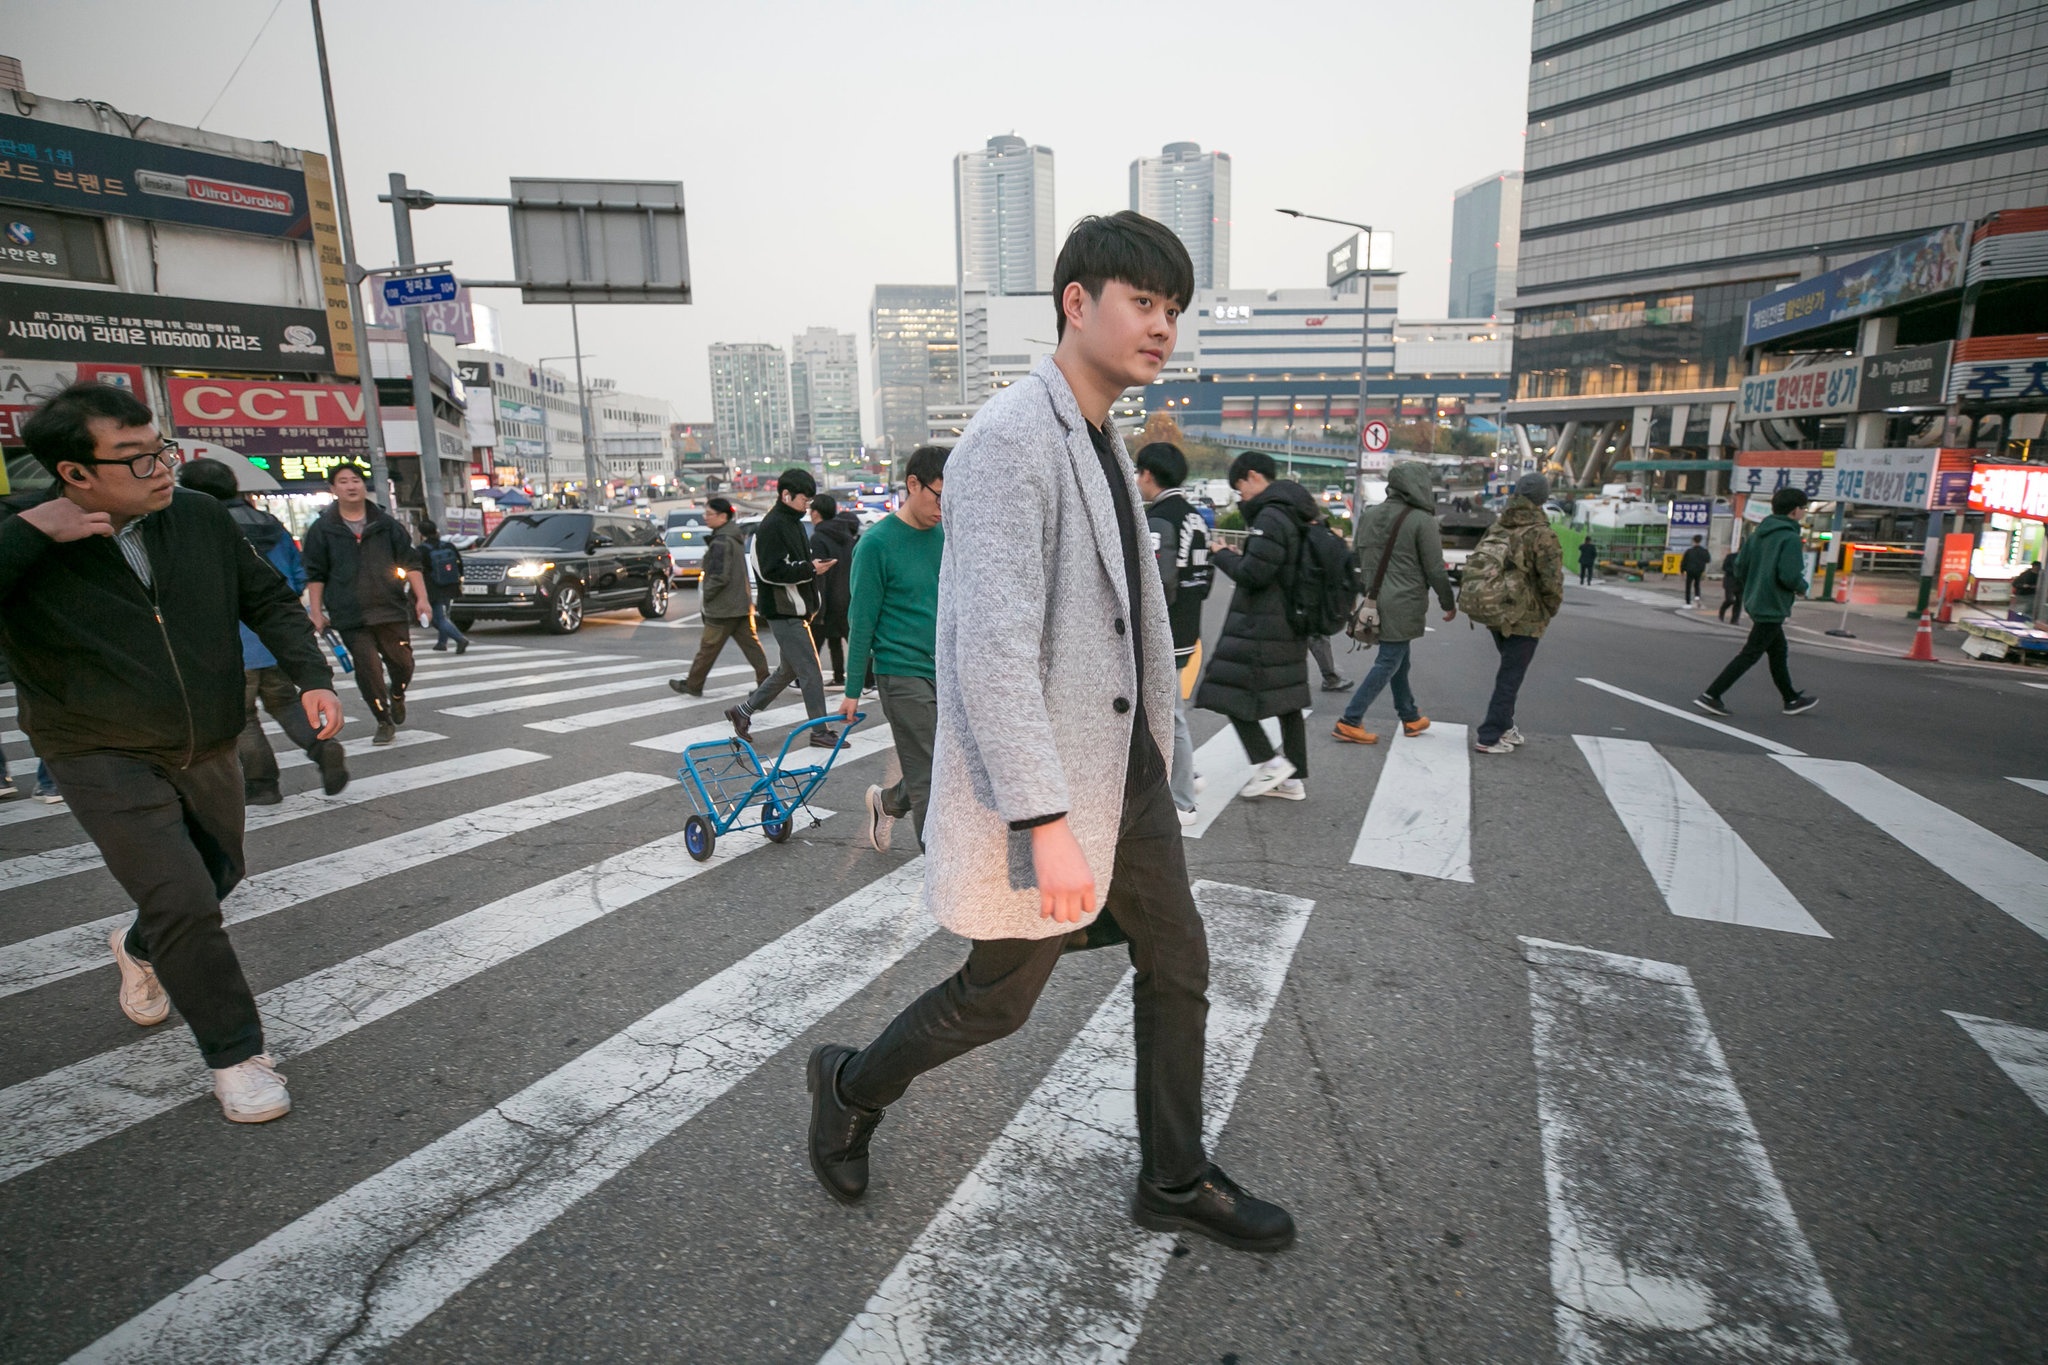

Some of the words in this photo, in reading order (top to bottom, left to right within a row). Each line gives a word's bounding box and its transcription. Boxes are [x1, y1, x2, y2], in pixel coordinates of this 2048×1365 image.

[44, 148, 74, 167] 1위
[53, 168, 128, 197] 브랜드
[193, 182, 230, 201] Ultra
[231, 189, 286, 211] Durable
[405, 278, 433, 294] 청파로
[328, 298, 348, 309] DVD
[8, 320, 87, 342] 사파이어
[92, 326, 147, 346] 라데온
[150, 330, 212, 349] HD5000
[216, 334, 262, 352] 시리즈
[1882, 358, 1932, 378] PlayStation
[183, 386, 365, 422] CCTV
[1673, 511, 1708, 523] 주차장
